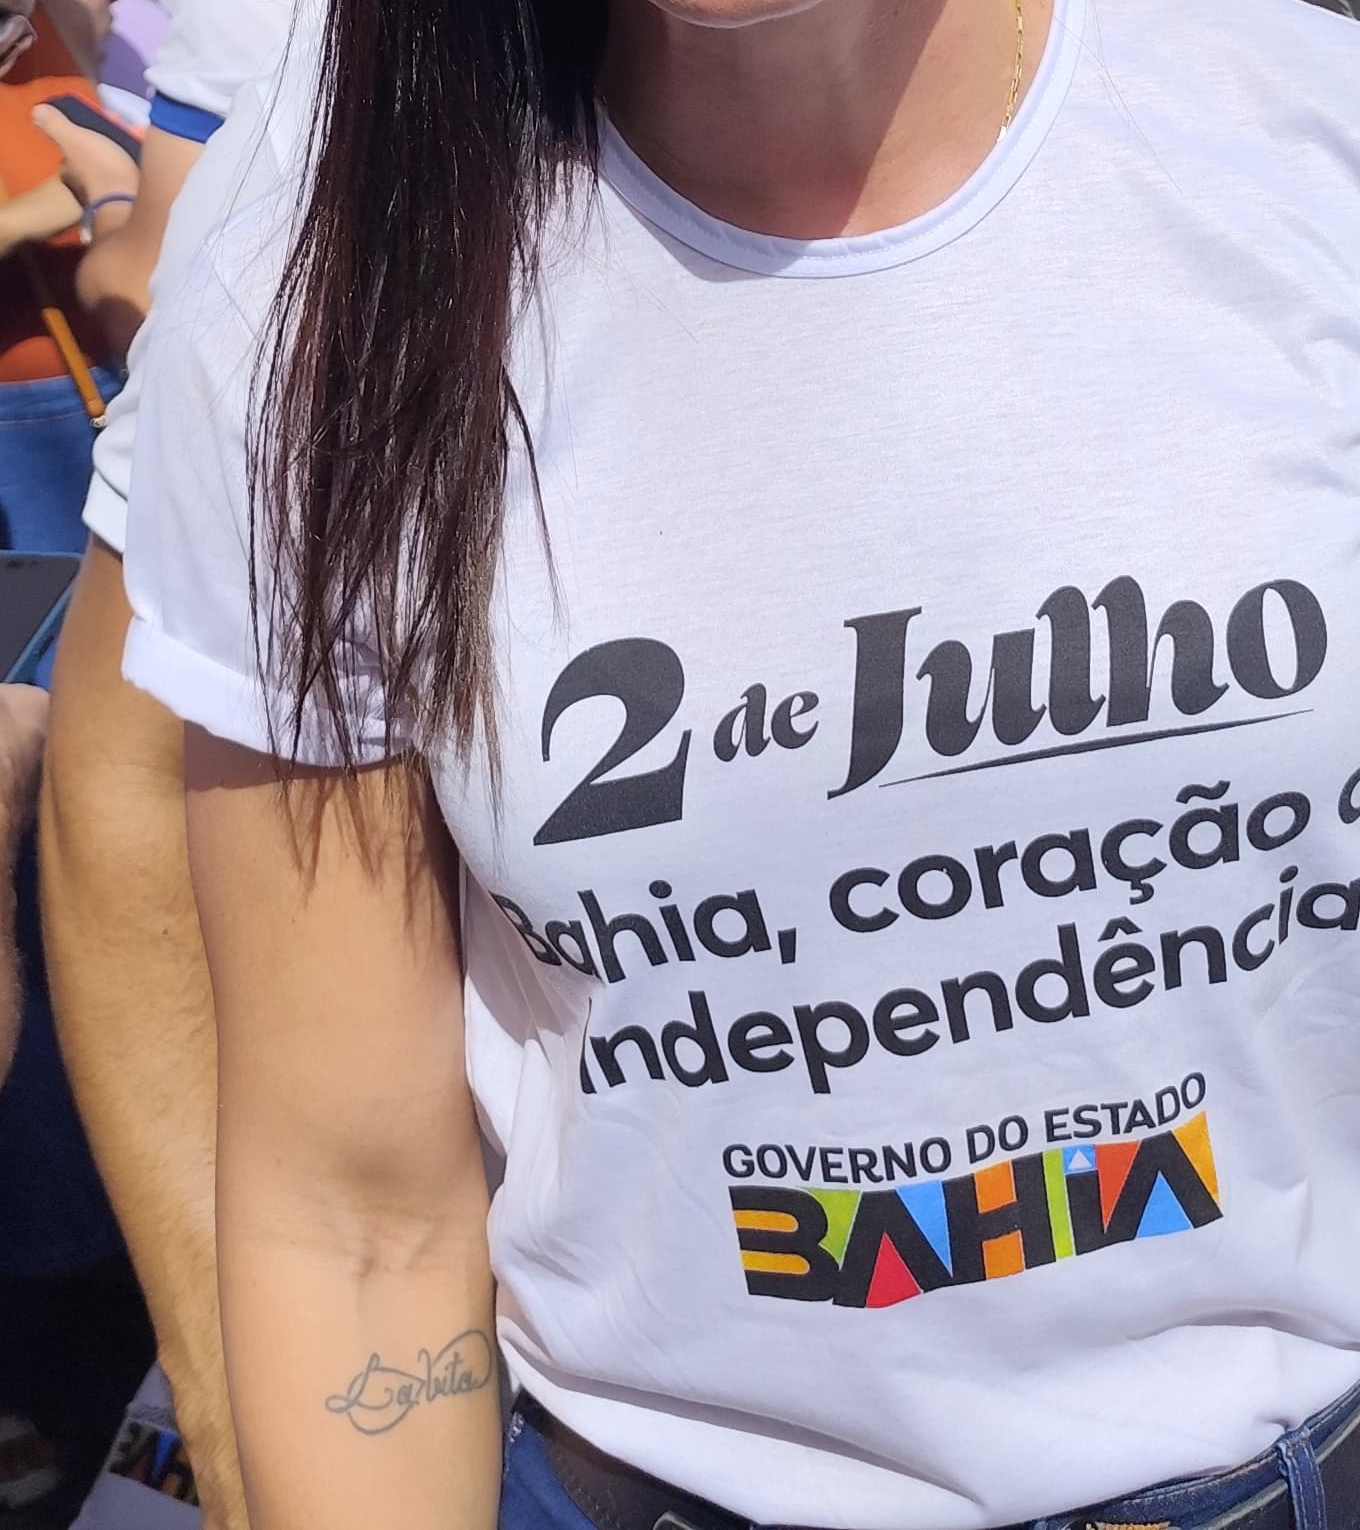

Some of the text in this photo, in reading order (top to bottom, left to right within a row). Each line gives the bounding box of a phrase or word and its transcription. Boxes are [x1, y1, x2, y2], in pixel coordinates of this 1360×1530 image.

[532, 575, 1329, 848] 2 de Julho
[487, 879, 798, 985] Bahia,
[828, 779, 1312, 935] coração
[722, 1071, 1208, 1184] GOVERNO DO ESTADO
[727, 1110, 1225, 1310] BAHIA
